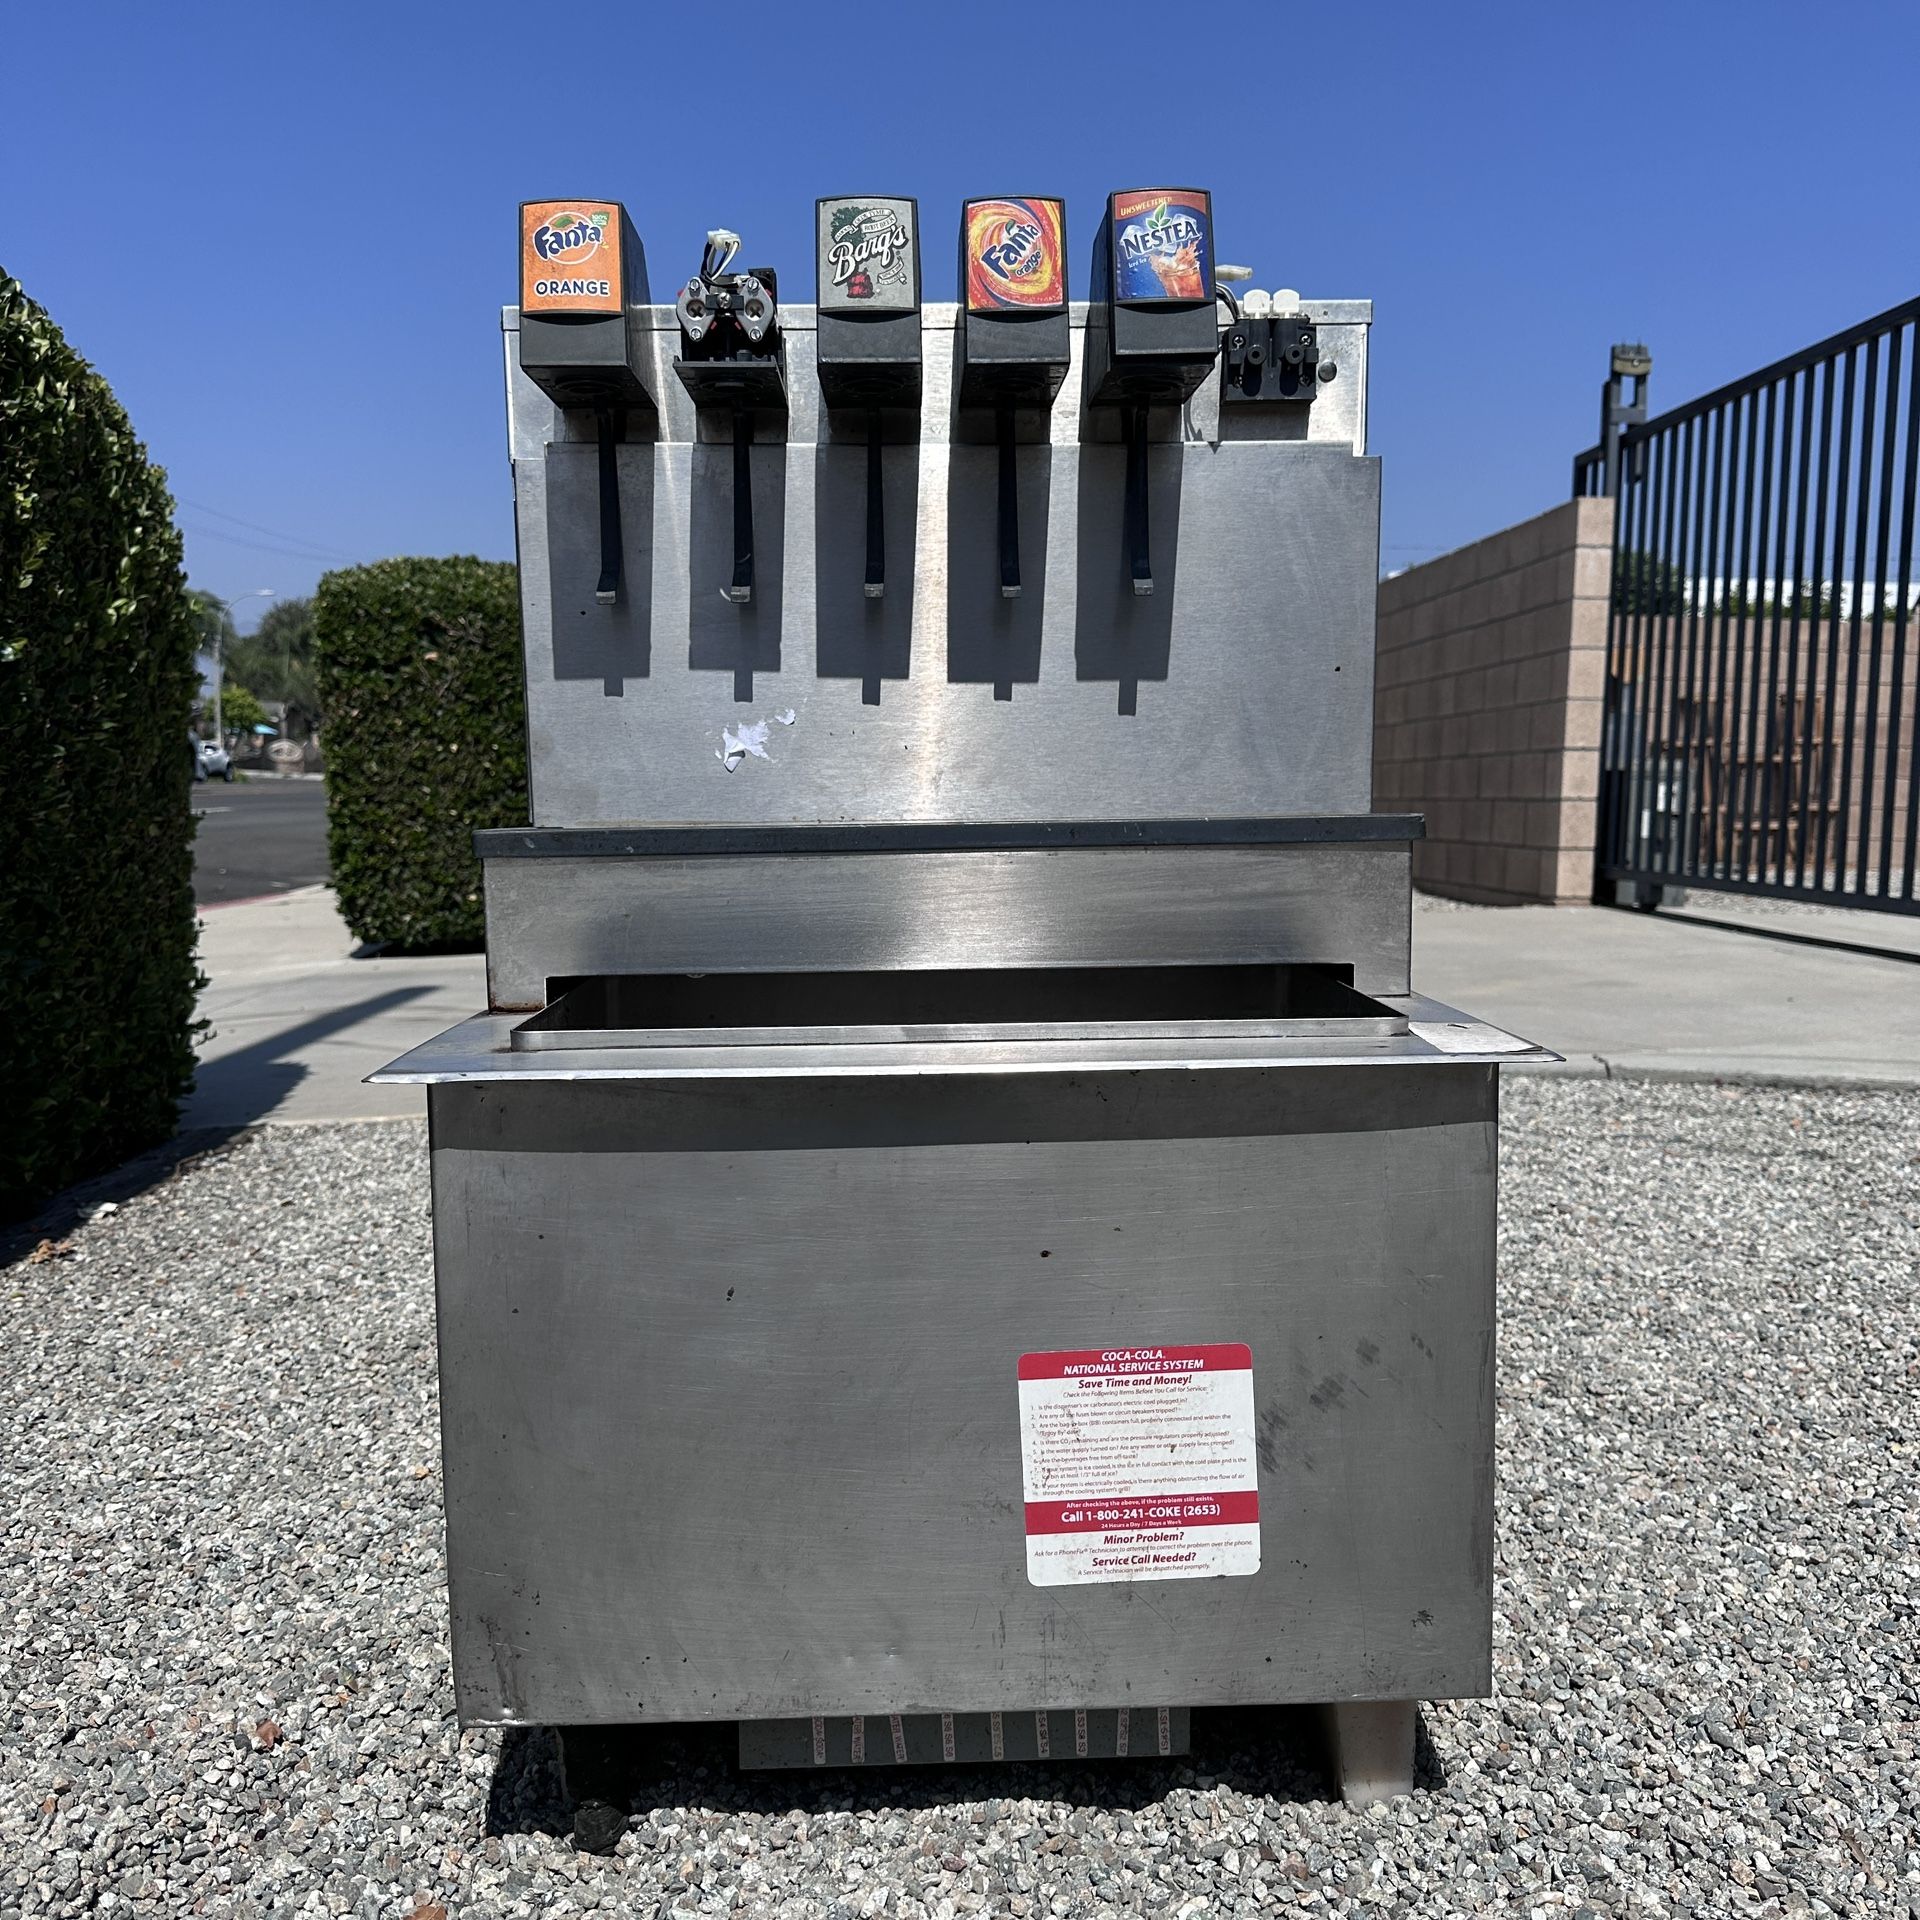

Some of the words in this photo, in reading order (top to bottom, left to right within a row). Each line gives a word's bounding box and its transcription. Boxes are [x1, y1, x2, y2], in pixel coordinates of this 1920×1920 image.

[533, 220, 602, 260] Fanta
[980, 223, 1040, 280] Fanta
[1122, 220, 1199, 259] NESTEA
[828, 225, 909, 286] Barq's
[1016, 250, 1041, 276] orange
[536, 280, 609, 296] ORANGE
[1063, 1363, 1116, 1375] NATIONAL
[1118, 1361, 1161, 1372] SERVICE
[1162, 1359, 1203, 1370] SYSTEM
[1078, 1378, 1102, 1388] Save
[1105, 1377, 1129, 1387] Time
[1132, 1376, 1152, 1386] and
[1153, 1374, 1192, 1387] Money!
[1061, 1511, 1082, 1522] Call
[1085, 1506, 1180, 1521] 1-800-241-COKE
[1182, 1503, 1220, 1517] (2653)
[1103, 1534, 1134, 1544] Minor
[1135, 1531, 1184, 1542] Problem?
[1092, 1555, 1128, 1566] Service
[1130, 1554, 1150, 1564] Call
[1152, 1552, 1196, 1563] Needed?
[854, 1736, 862, 1760] WATER
[896, 1736, 904, 1760] WATER
